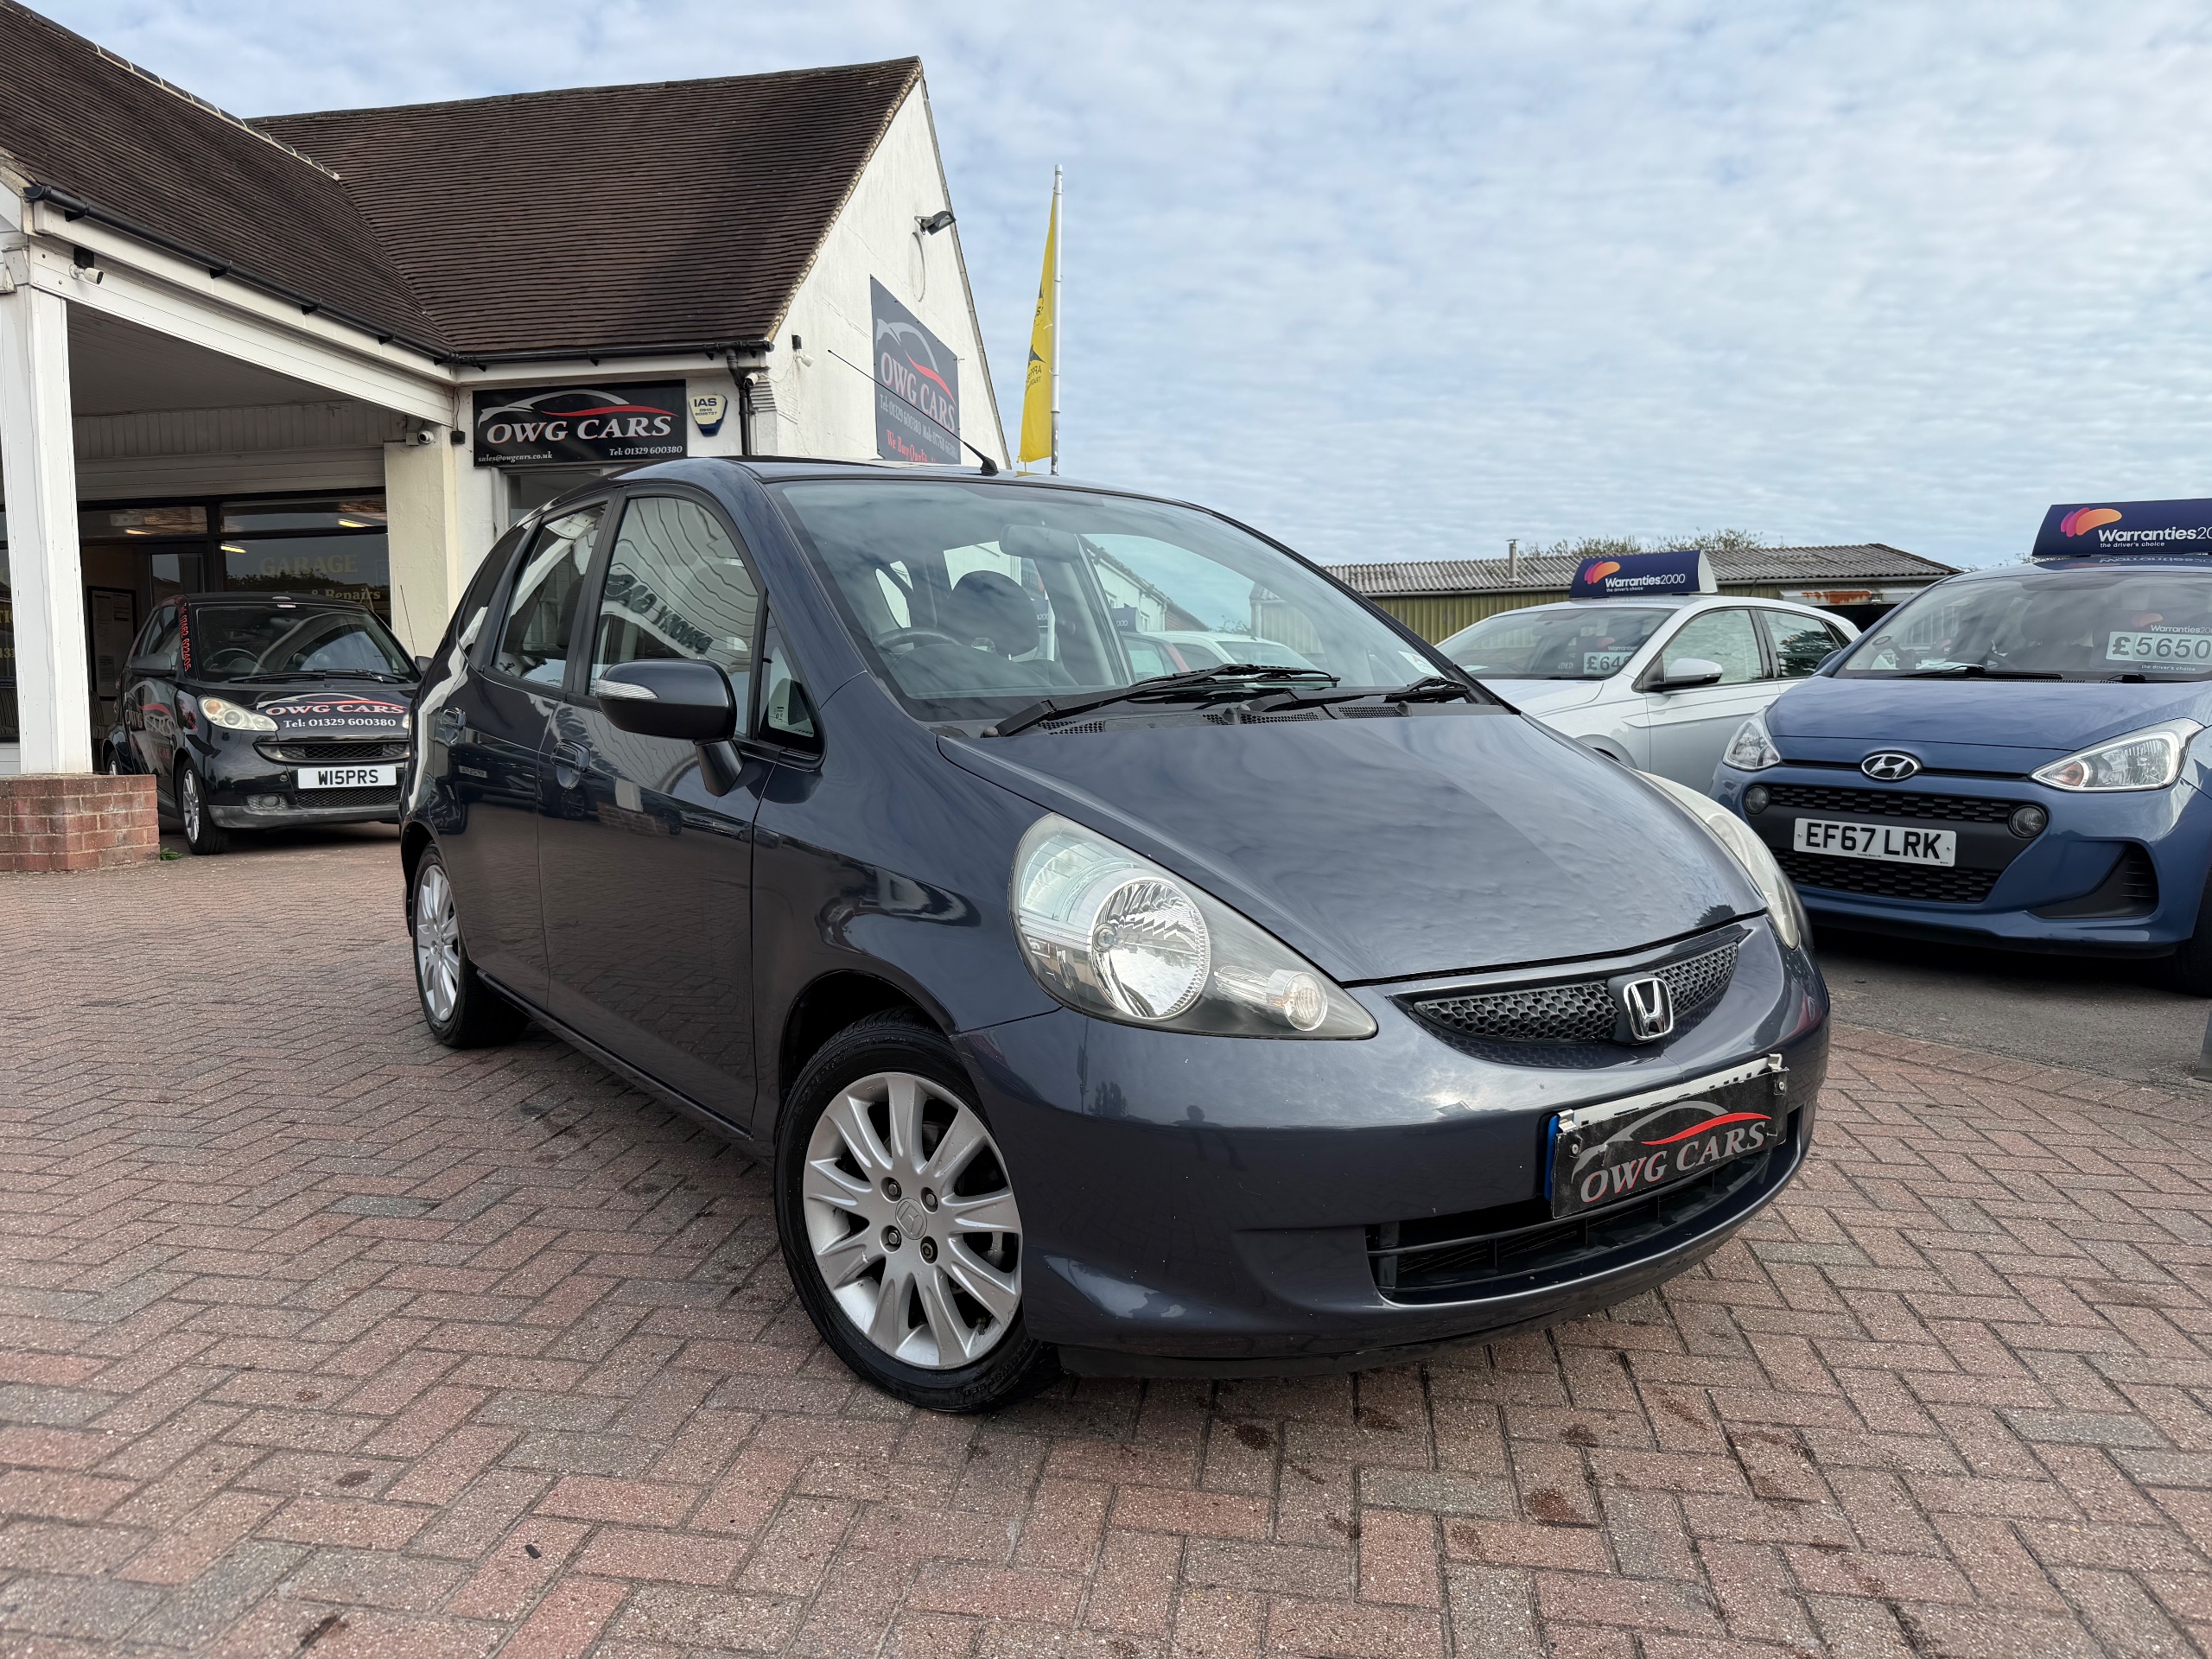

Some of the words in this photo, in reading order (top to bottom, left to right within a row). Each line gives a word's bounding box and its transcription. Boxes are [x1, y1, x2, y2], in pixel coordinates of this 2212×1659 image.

[694, 398, 717, 407] IAS
[880, 352, 918, 406] OWG
[920, 383, 956, 435] CARS
[486, 421, 569, 444] OWG
[577, 416, 672, 440] CARS
[478, 450, 554, 463] sales@owgcars.co.uk
[609, 448, 623, 456] Tel:
[625, 447, 649, 455] 01329
[650, 445, 683, 454] 600380
[259, 554, 359, 577] GARAGE
[1605, 574, 1685, 588] Warranties2000
[2112, 636, 2212, 659] £5650
[265, 704, 331, 716] OWG
[336, 703, 405, 715] CARS
[283, 719, 306, 728] Tel:
[308, 718, 346, 727] 01329
[348, 718, 397, 728] 600380
[1806, 822, 1876, 853] EF67
[1884, 830, 1942, 860] LRK
[1580, 1153, 1667, 1203] OWG
[1676, 1121, 1765, 1171] CARS
